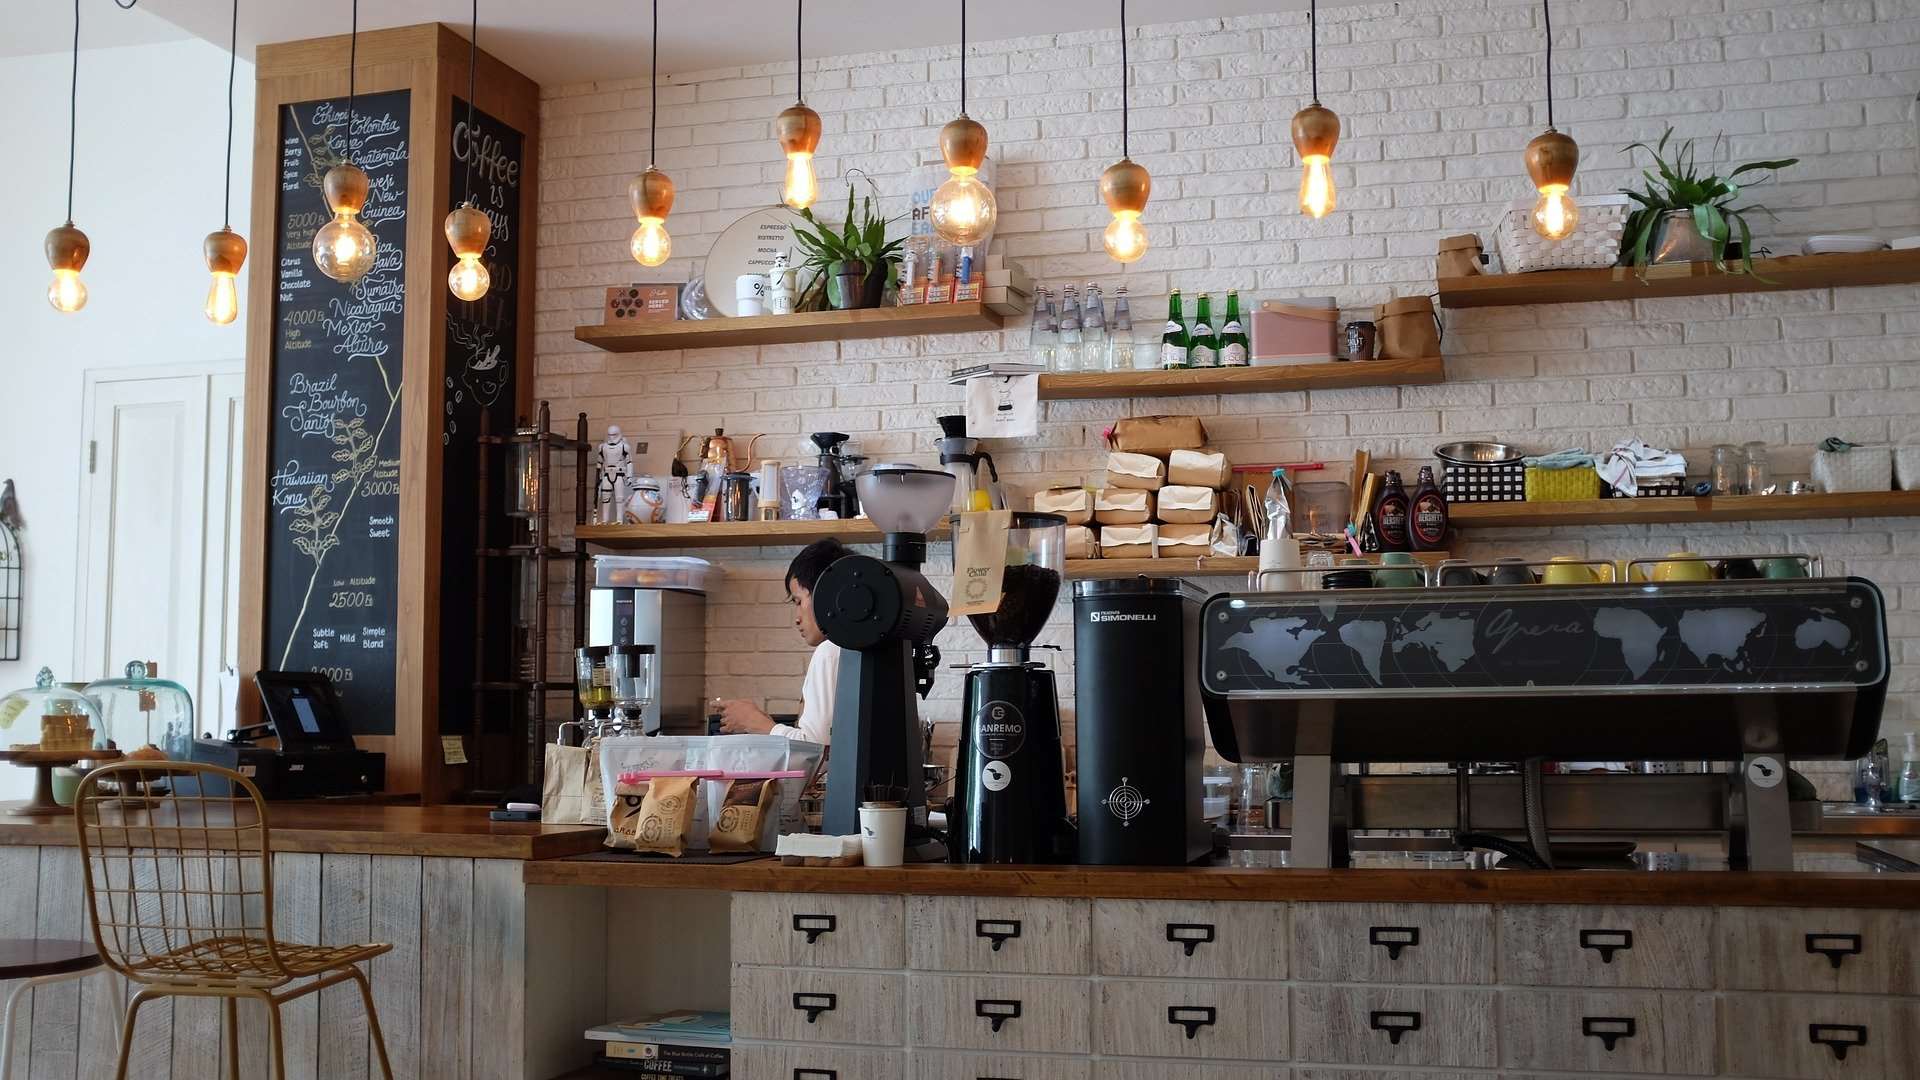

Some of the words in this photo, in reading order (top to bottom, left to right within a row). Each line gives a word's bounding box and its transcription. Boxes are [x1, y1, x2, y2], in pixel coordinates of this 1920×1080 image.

[349, 113, 400, 141] Colombia
[284, 148, 301, 157] Berry
[351, 141, 410, 169] Guatemala
[453, 121, 519, 187] Coffee
[283, 160, 299, 168] Fruit
[283, 171, 298, 180] Spice
[370, 188, 404, 203] New
[490, 184, 504, 209] is
[361, 200, 406, 226] Guinea
[287, 213, 317, 230] 5000
[281, 270, 303, 279] Vanilla
[280, 280, 311, 290] Chocolate
[355, 274, 406, 303] Sumatra
[329, 298, 403, 321] Nicaragua
[284, 310, 317, 326] 4000
[322, 318, 386, 336] Mexico
[333, 334, 388, 361] Altura
[290, 372, 337, 396] Brazil
[308, 390, 367, 417] Bourbon
[282, 401, 336, 438] Santos
[271, 460, 335, 492] Hawaiian
[361, 481, 392, 497] 3000
[272, 487, 308, 514] Kona
[369, 515, 394, 525] Smooth
[369, 528, 391, 538] Sweet
[329, 592, 364, 608] 2500
[1101, 614, 1156, 622] SIMONELLI
[313, 628, 335, 638] Subtle
[340, 634, 356, 643] Mild
[362, 626, 386, 637] Simple
[313, 640, 329, 649] Soft
[363, 639, 384, 649] Bland
[977, 724, 1022, 734] ANREMO
[644, 1059, 672, 1072] COFFEE
